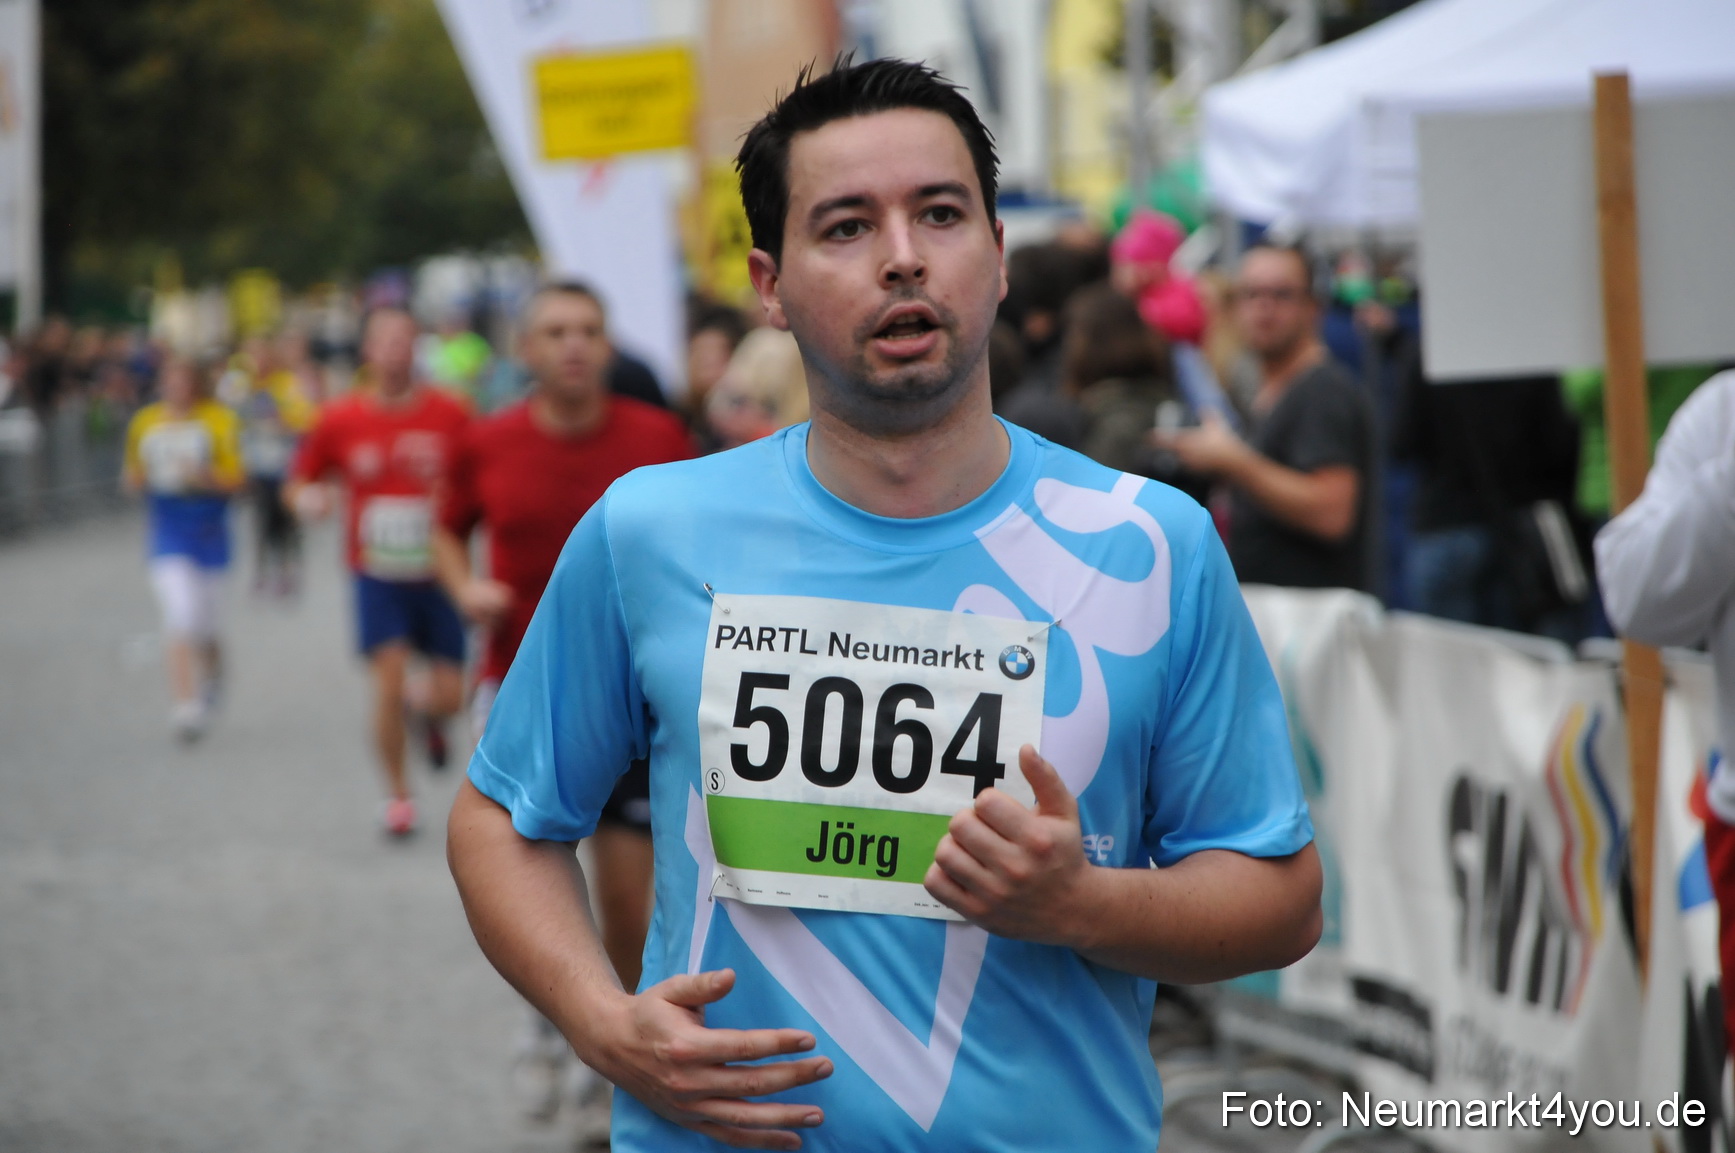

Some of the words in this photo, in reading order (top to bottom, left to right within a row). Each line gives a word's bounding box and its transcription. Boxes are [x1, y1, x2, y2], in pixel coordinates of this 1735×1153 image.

[714, 624, 818, 655] PARTL
[827, 631, 985, 671] Neumarkt
[729, 671, 1006, 799] 5064
[805, 820, 900, 878] Jörg
